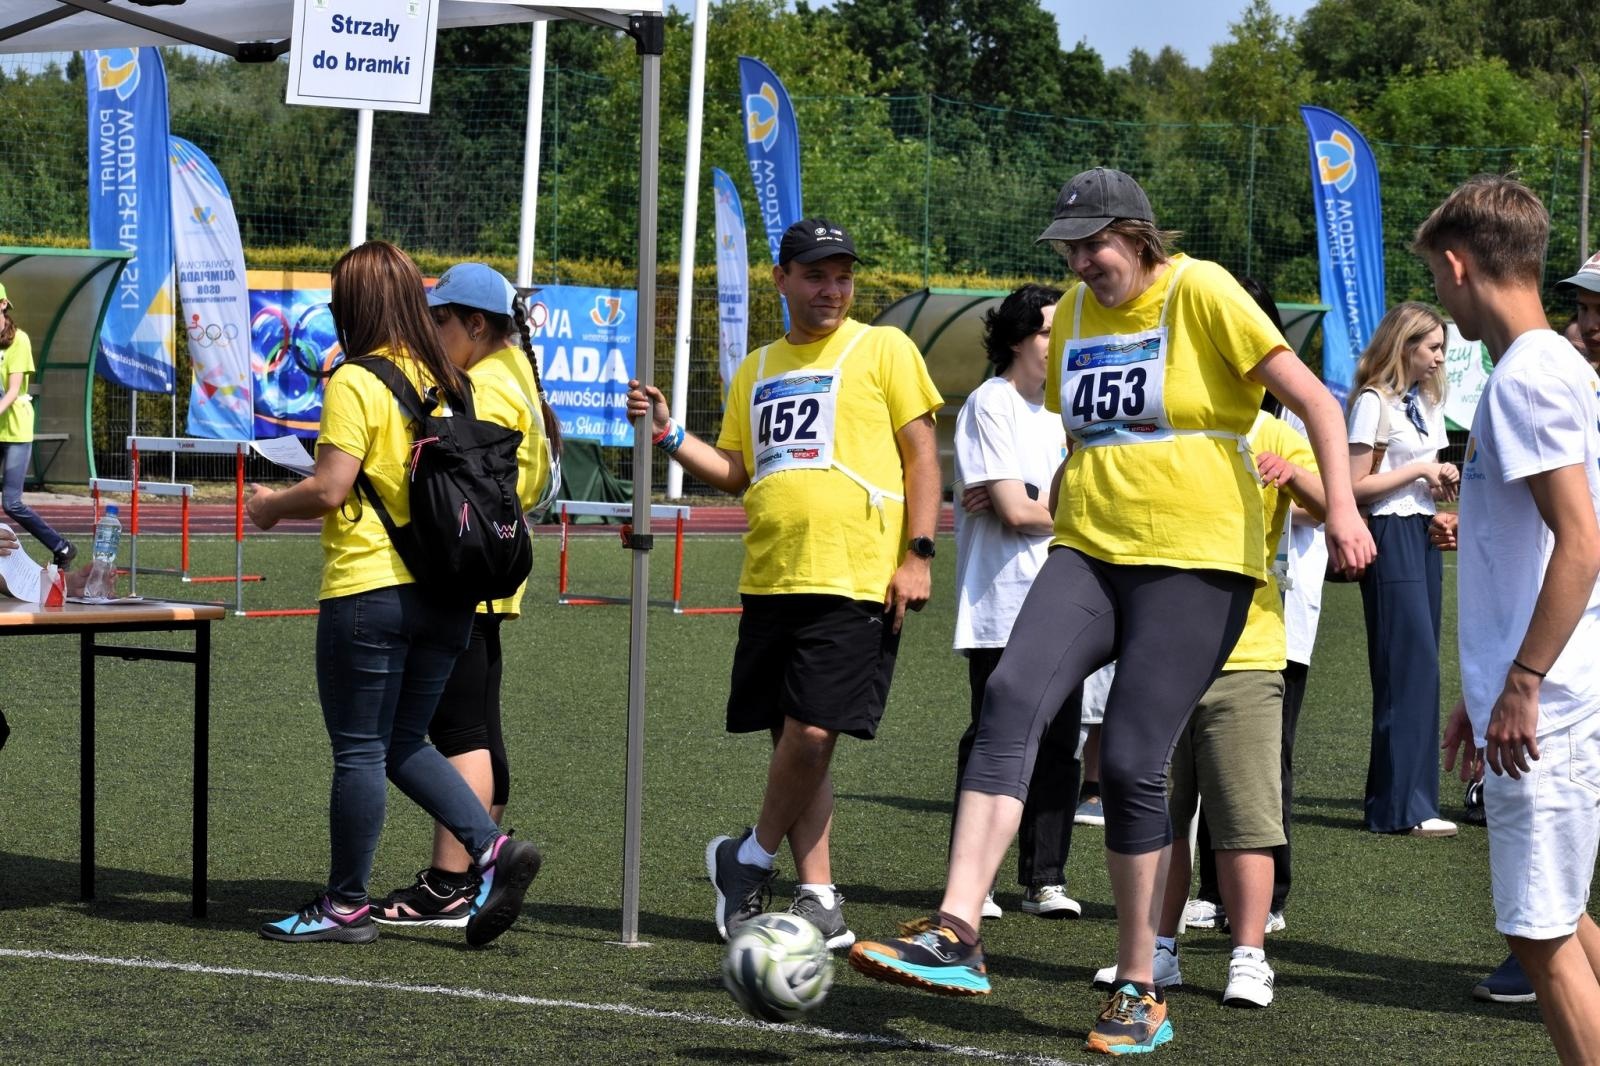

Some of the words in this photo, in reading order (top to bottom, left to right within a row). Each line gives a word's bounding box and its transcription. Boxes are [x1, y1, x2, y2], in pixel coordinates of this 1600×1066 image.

[331, 14, 400, 43] Strzały
[312, 50, 338, 70] do
[345, 52, 411, 75] bramki
[1072, 367, 1147, 422] 453
[758, 397, 820, 446] 452
